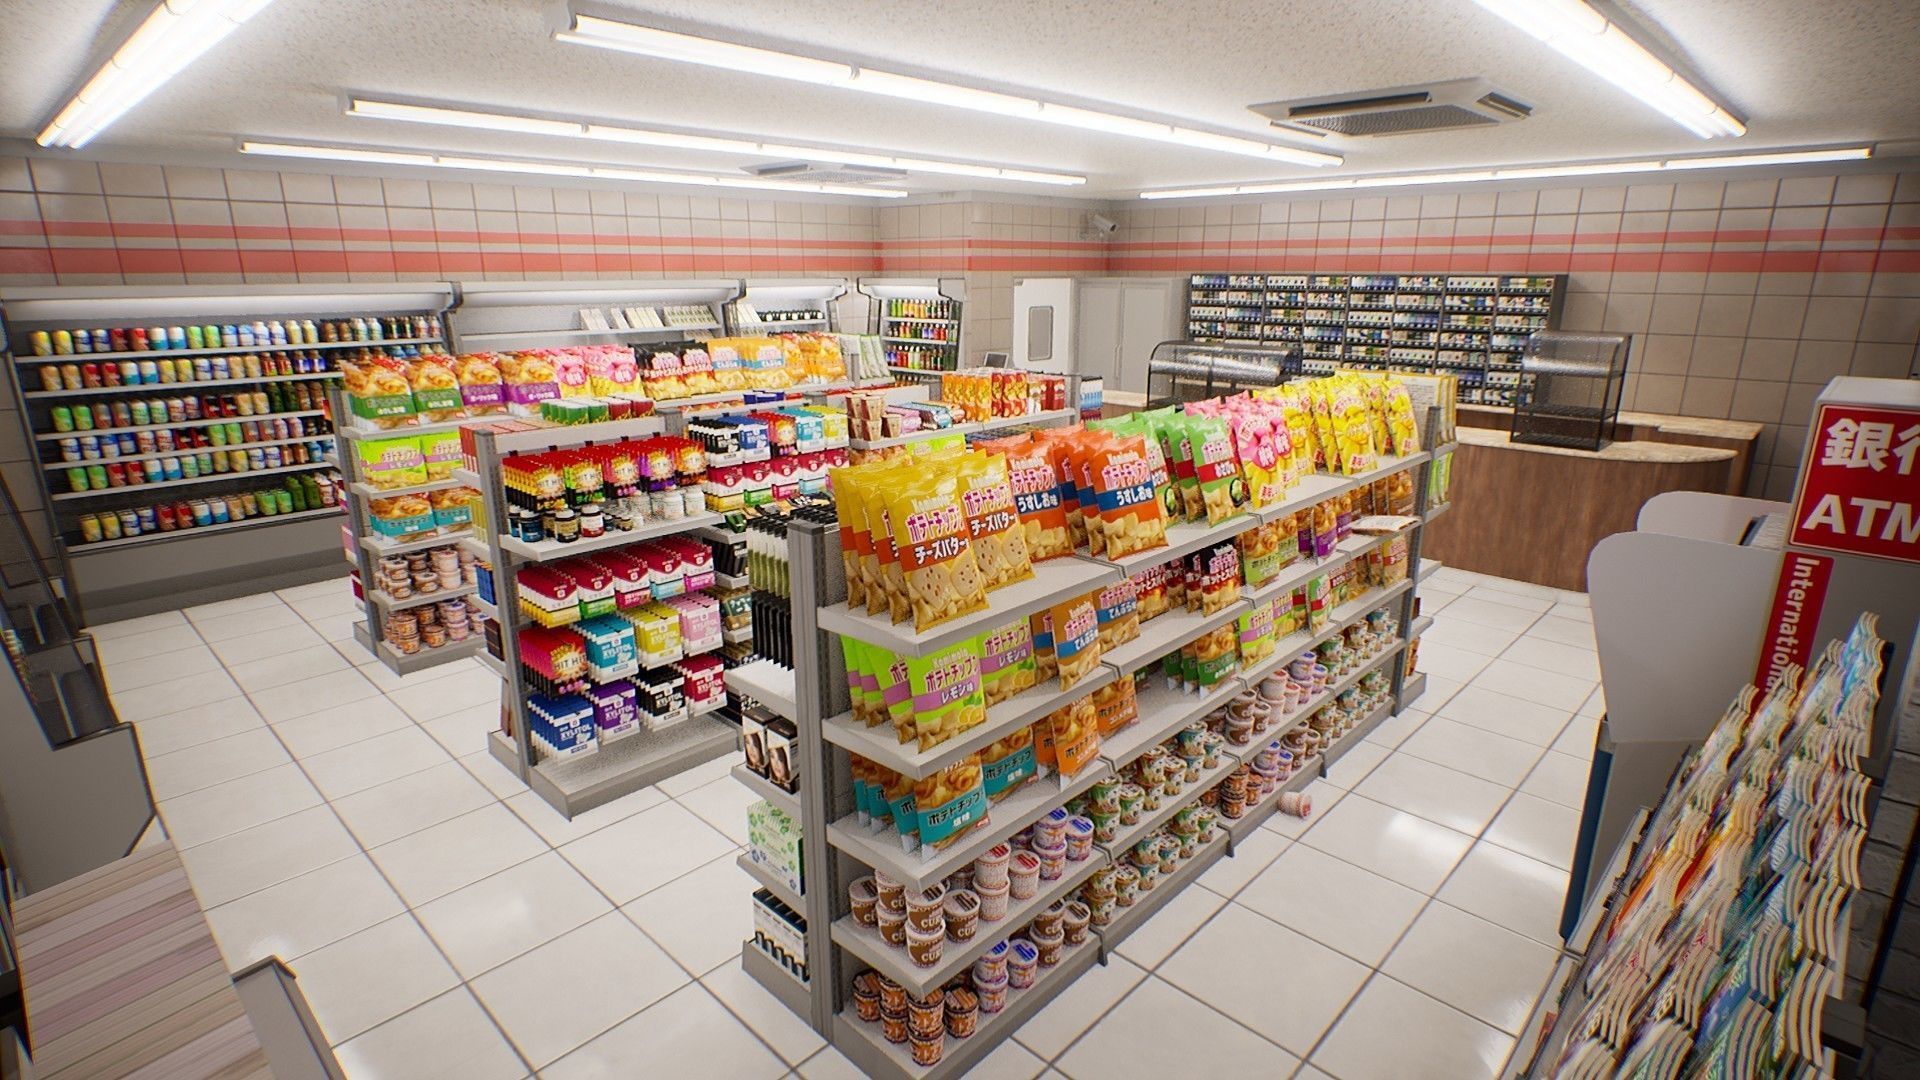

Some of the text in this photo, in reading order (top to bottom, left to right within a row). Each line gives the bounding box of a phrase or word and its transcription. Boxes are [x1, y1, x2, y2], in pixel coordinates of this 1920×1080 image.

[1802, 494, 1920, 543] ATM
[602, 643, 633, 659] XYLITOL
[605, 705, 635, 720] XYLITOL
[560, 724, 592, 740] XYLITOL
